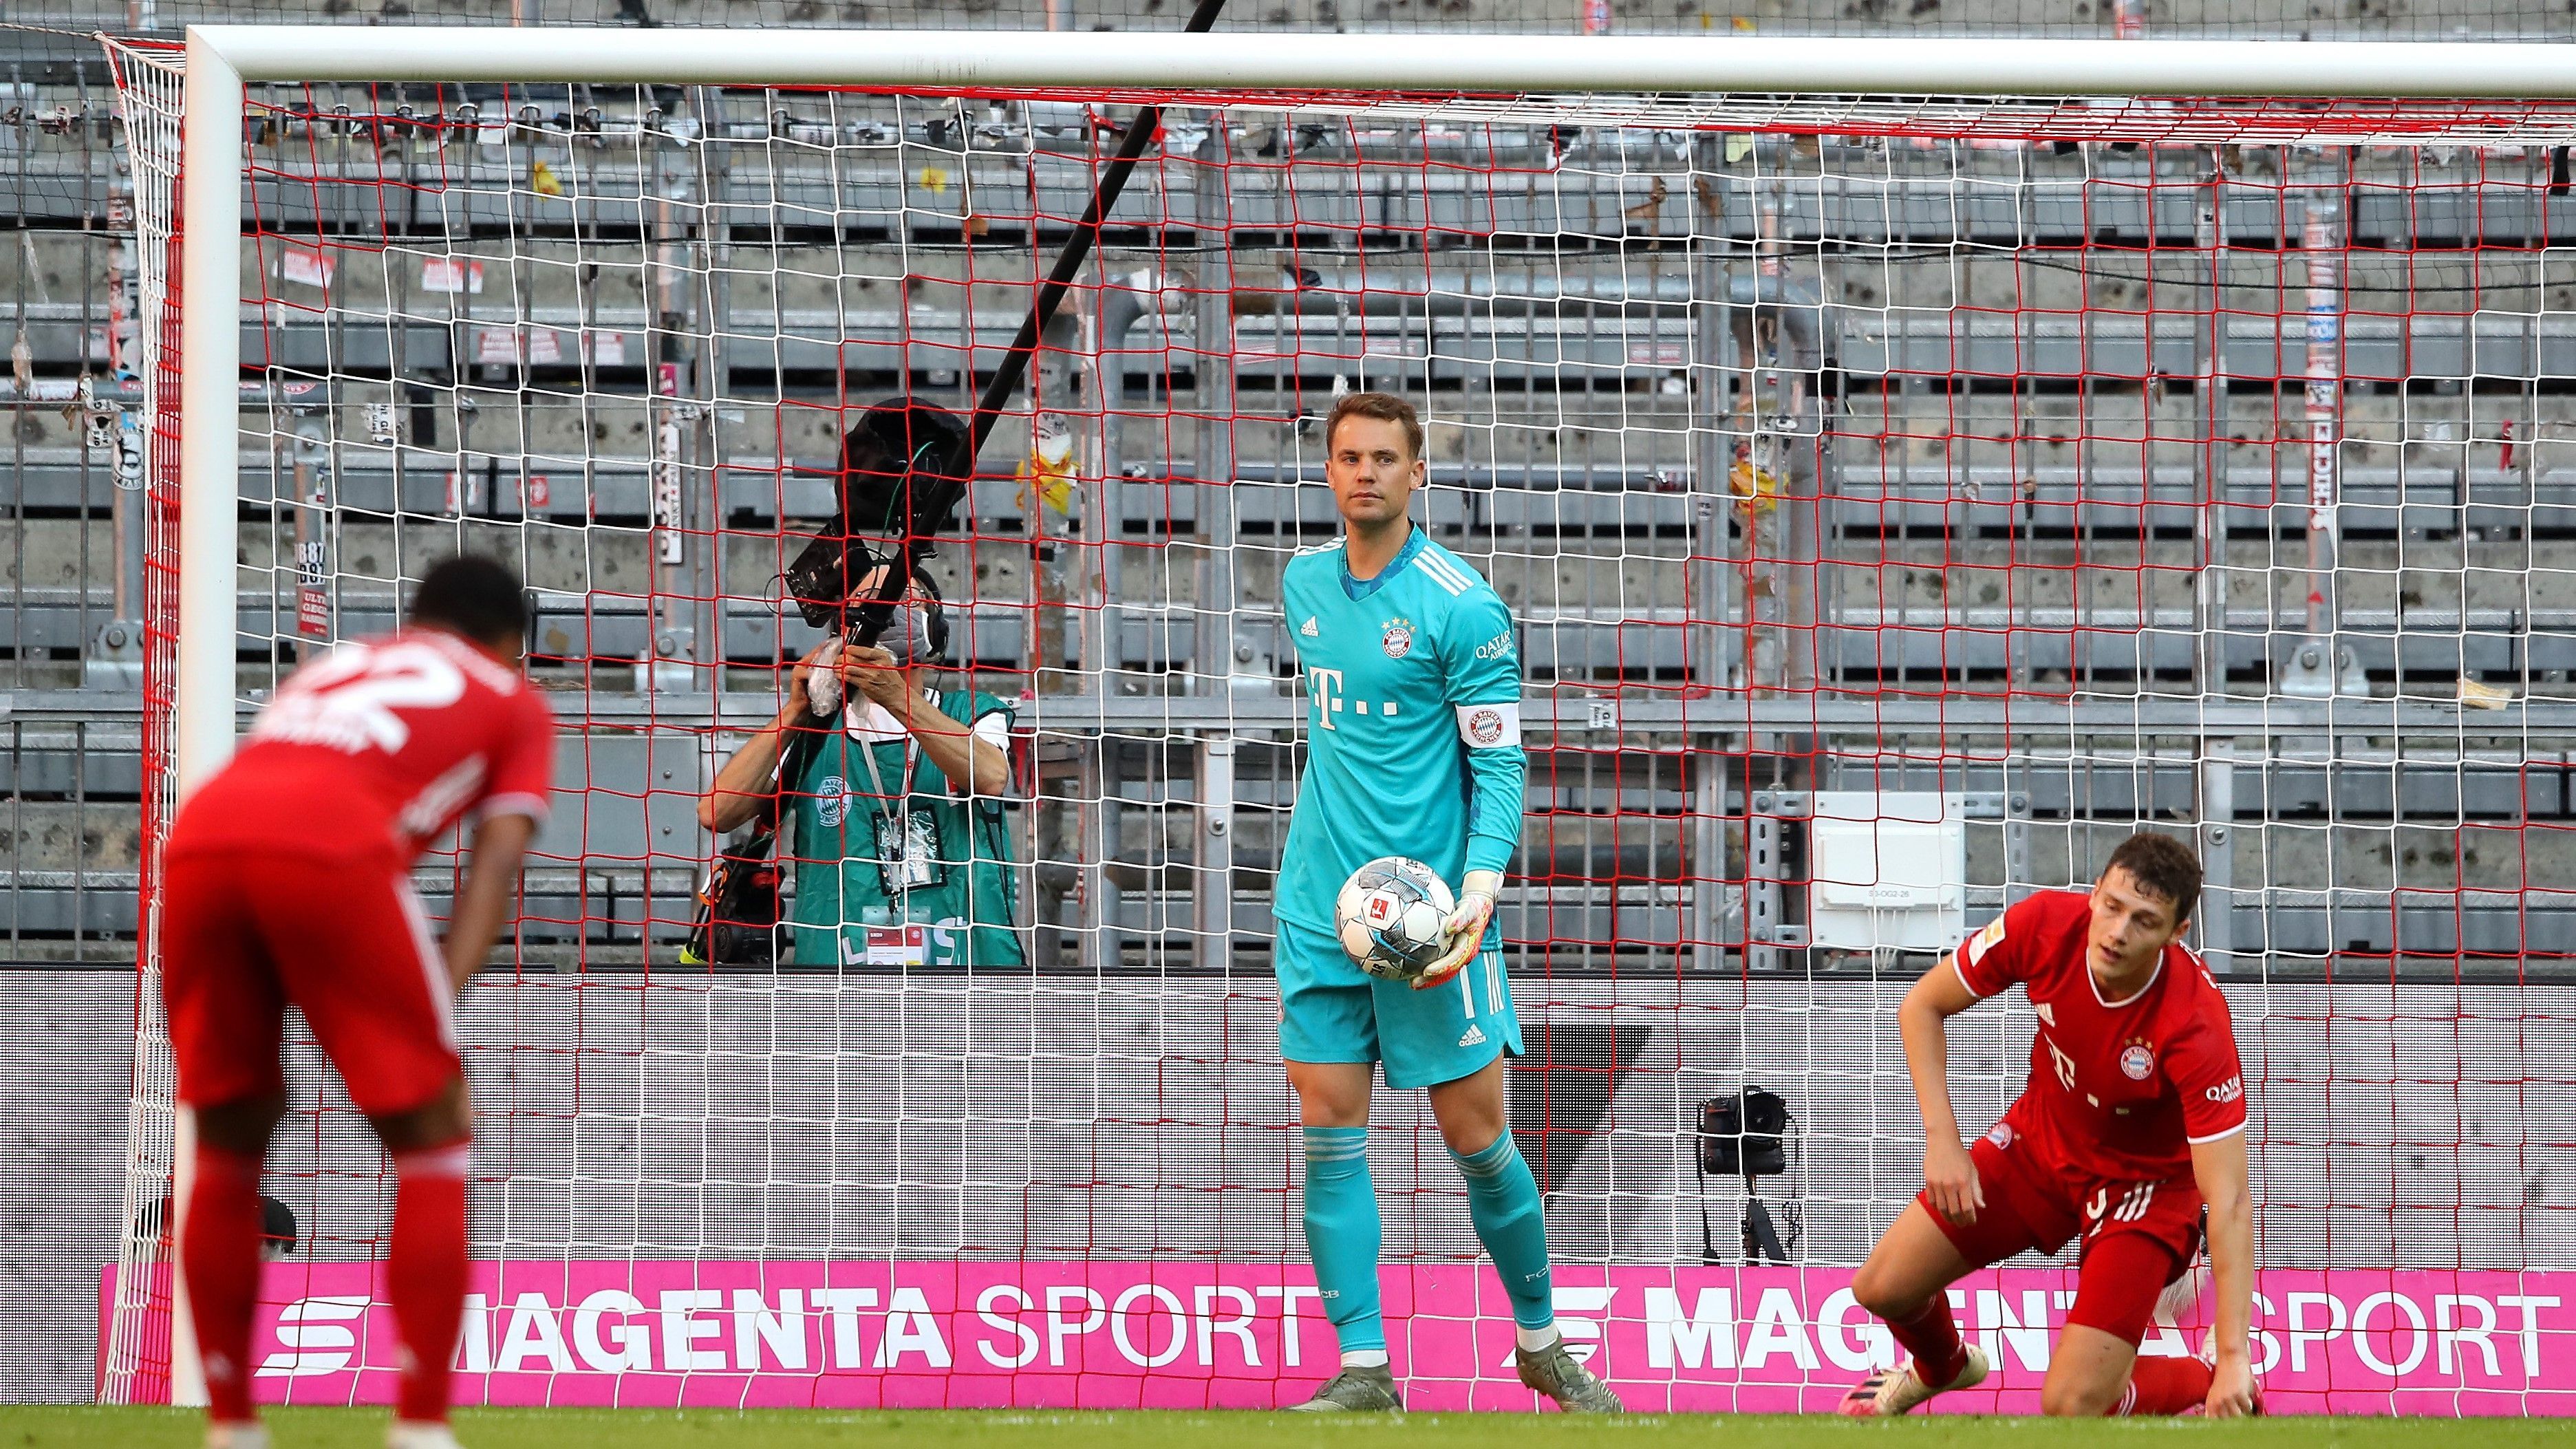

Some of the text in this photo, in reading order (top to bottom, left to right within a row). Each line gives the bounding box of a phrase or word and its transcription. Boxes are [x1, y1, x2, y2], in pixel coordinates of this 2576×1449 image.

[1475, 630, 1511, 660] QATAR
[1478, 711, 1501, 724] BAYERN
[1472, 729, 1501, 743] MÜNCHEN
[1459, 1035, 1487, 1047] adidas
[976, 1284, 1320, 1369] SPORT
